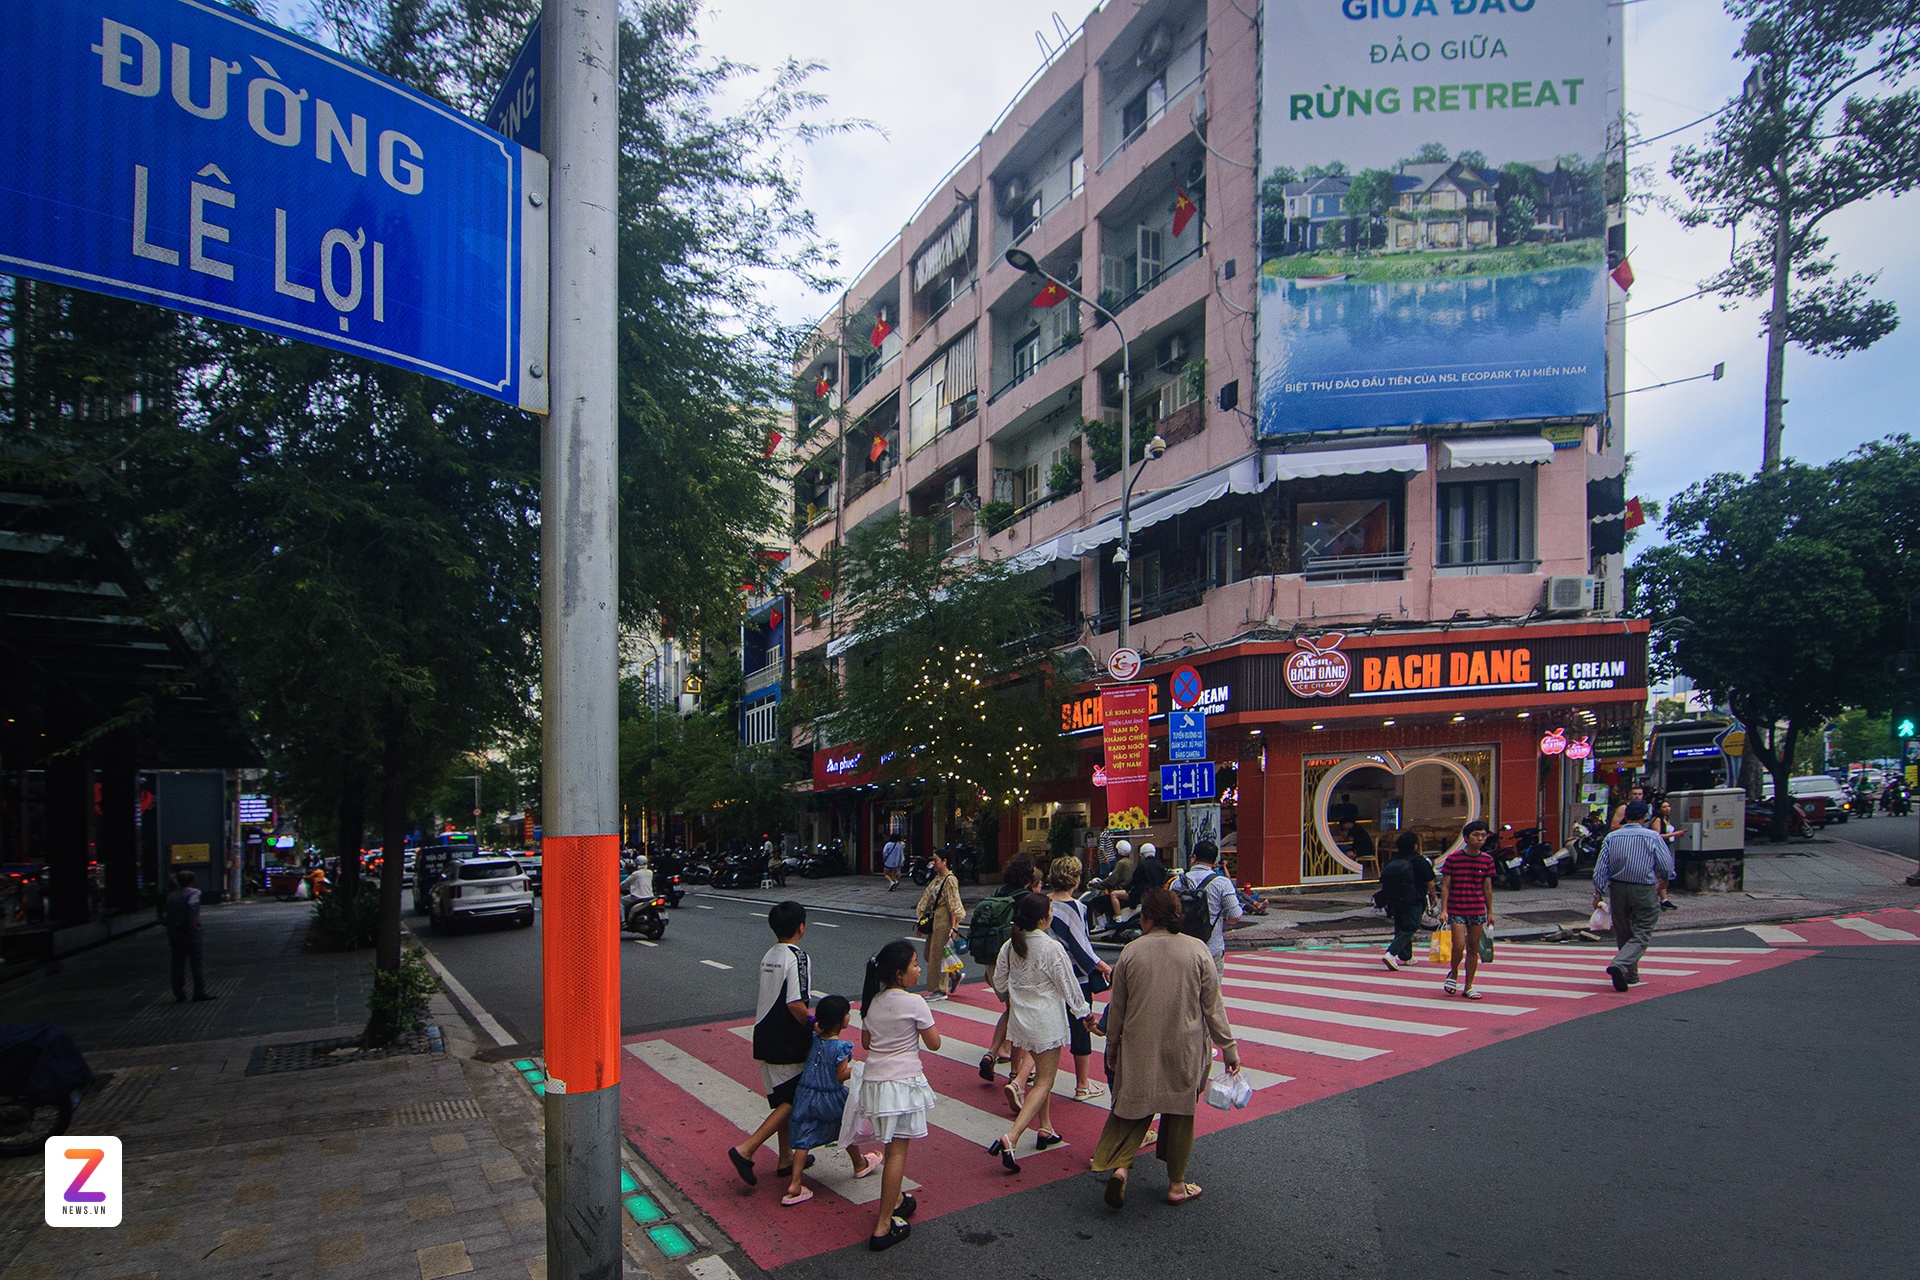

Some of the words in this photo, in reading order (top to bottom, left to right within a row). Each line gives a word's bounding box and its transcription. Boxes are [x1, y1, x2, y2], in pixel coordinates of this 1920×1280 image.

[1370, 35, 1431, 63] ĐẢO
[1441, 34, 1508, 60] GIỮA
[91, 18, 425, 195] ĐƯỜNG
[1290, 84, 1401, 121] RỪNG
[1413, 78, 1584, 113] RETREAT
[132, 163, 235, 281] LÊ
[274, 208, 384, 332] LỢI
[1285, 380, 1308, 394] BIỆT
[1310, 379, 1333, 392] THỰ
[1335, 376, 1360, 390] ĐẢO
[1387, 374, 1412, 386] TIÊN
[1413, 372, 1437, 385] CỦA
[1439, 374, 1459, 384] NSL
[1461, 370, 1512, 382] ECOPARK
[1514, 368, 1531, 380] TẠI
[1562, 365, 1587, 376] NAM
[1363, 653, 1442, 692] BACH
[1450, 648, 1531, 687] DANG
[1545, 663, 1569, 680] ICE
[1572, 661, 1625, 679] CREAM
[1545, 680, 1565, 692] Tea
[1567, 680, 1575, 691] &
[1577, 678, 1613, 690] Coffee
[1193, 686, 1228, 706] REAM
[1104, 735, 1127, 743] KHÁNG
[1128, 732, 1147, 741] CHIẾN
[1130, 725, 1139, 733] BỘ
[1107, 744, 1126, 753] RẠNG
[1113, 752, 1128, 760] HÀO
[1112, 762, 1125, 770] VIỆT
